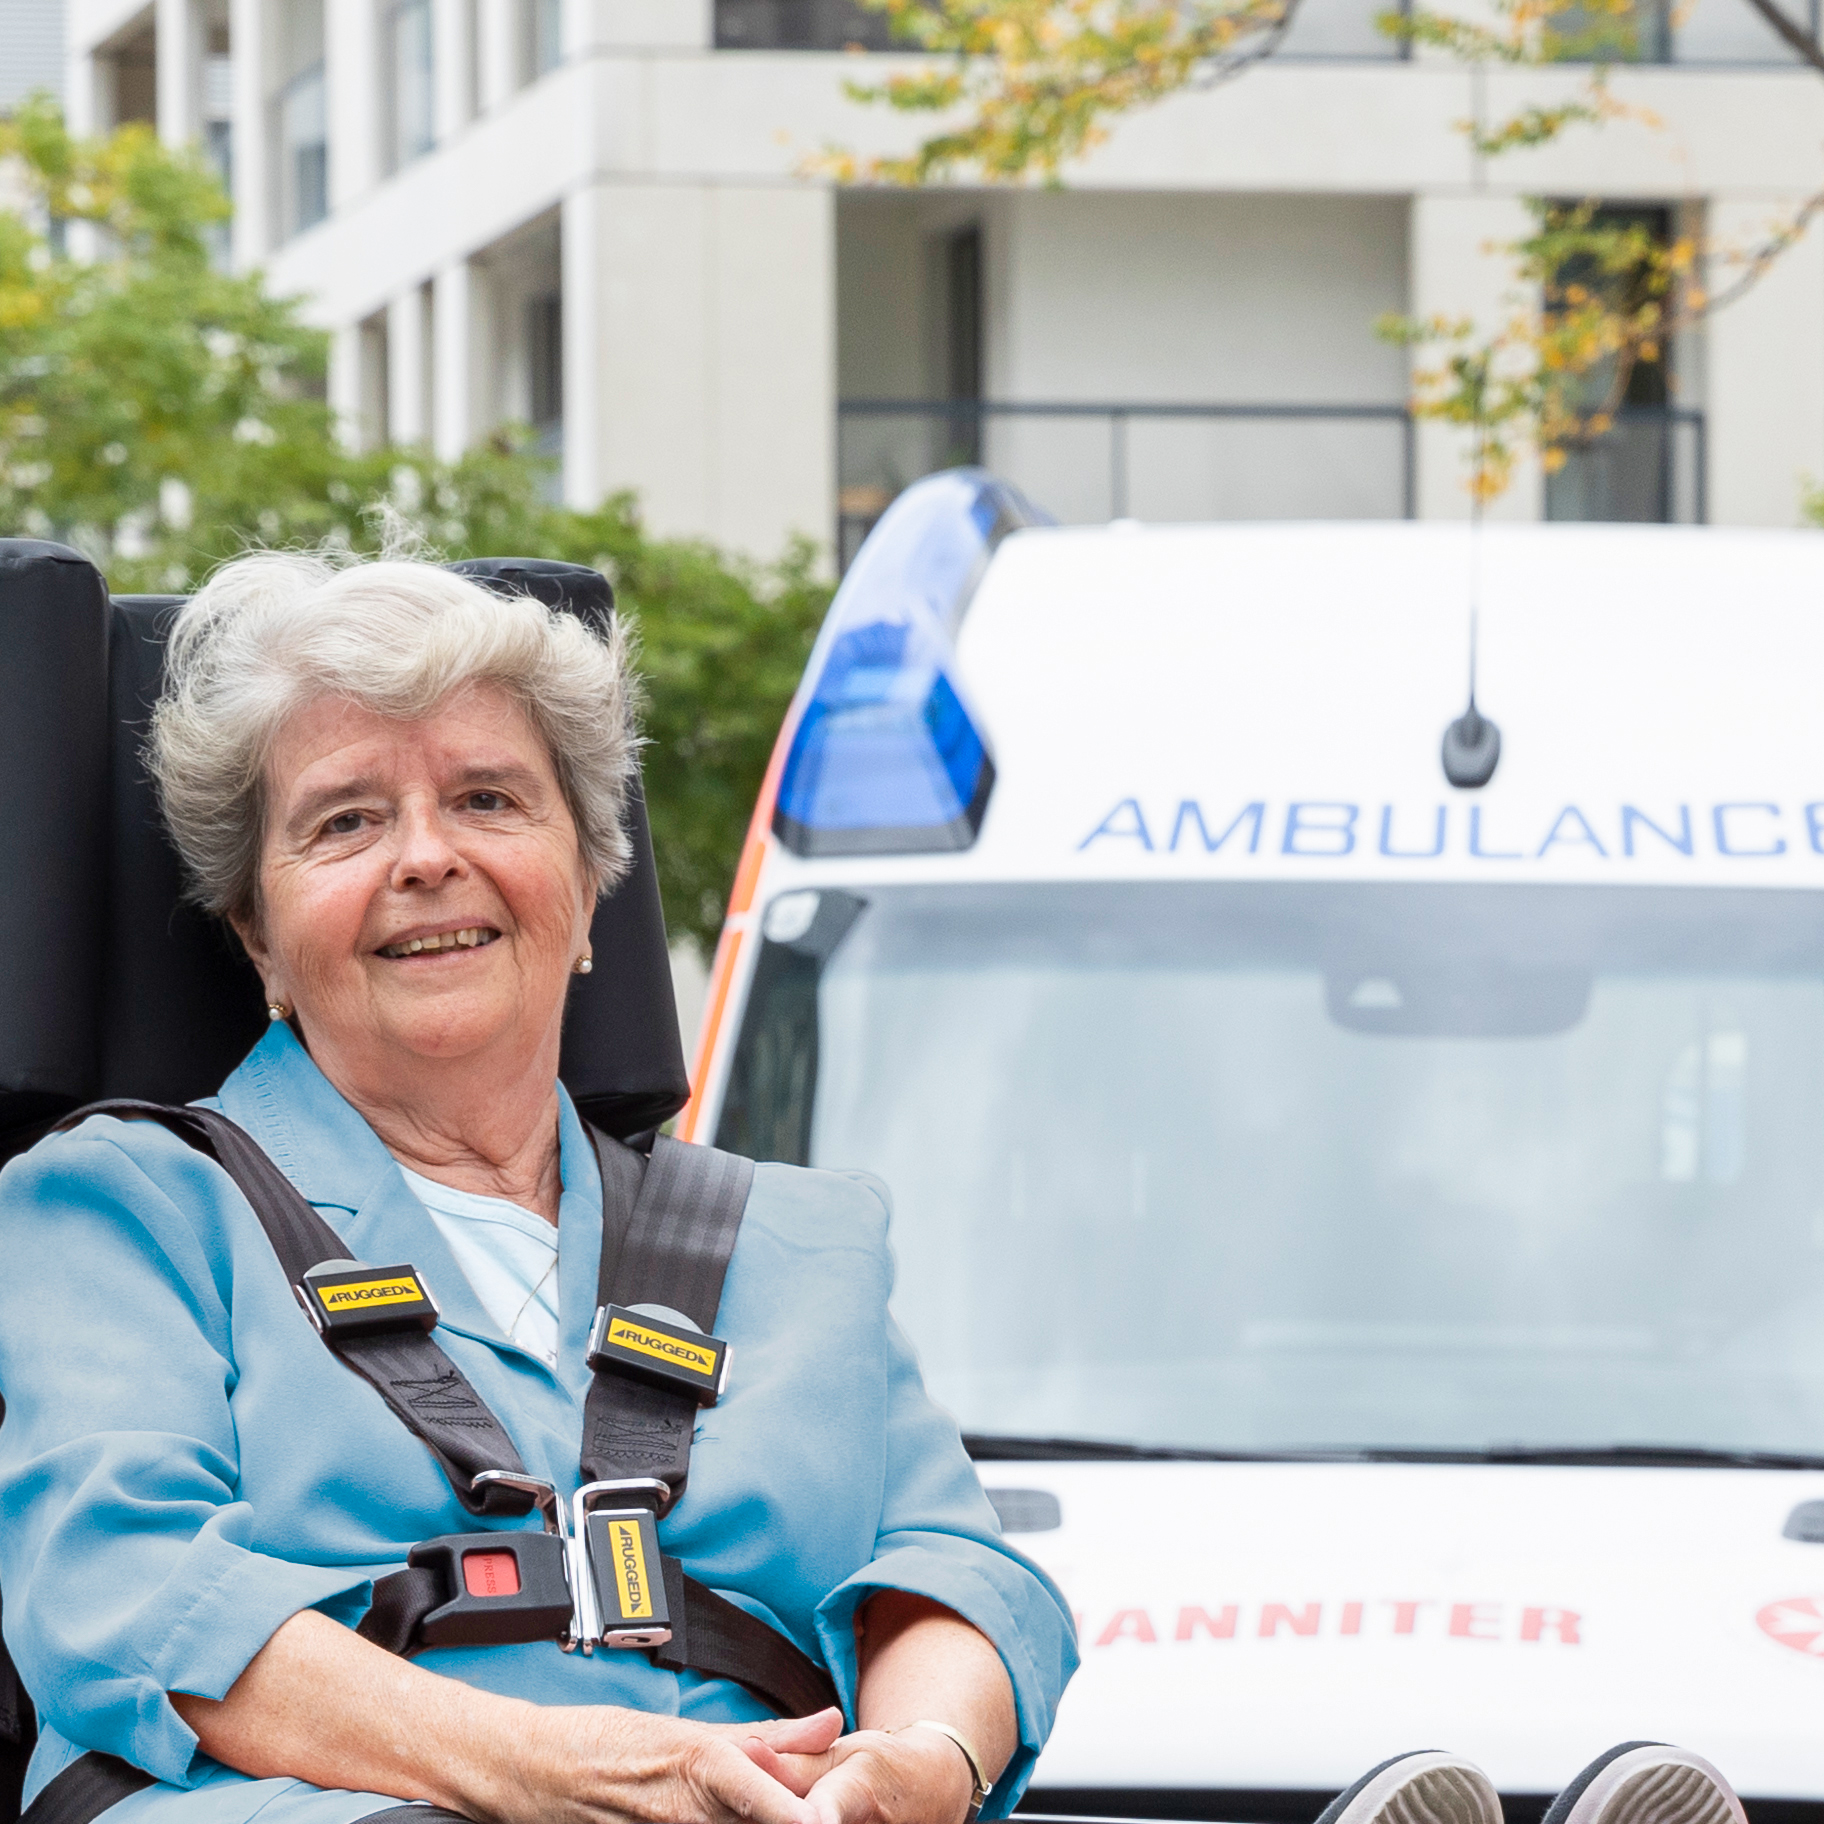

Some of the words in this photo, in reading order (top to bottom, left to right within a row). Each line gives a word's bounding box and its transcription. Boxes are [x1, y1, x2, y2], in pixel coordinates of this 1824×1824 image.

[337, 1285, 404, 1303] RUGGED
[626, 1331, 697, 1361] RUGGED
[483, 1558, 497, 1594] PRESS
[620, 1535, 642, 1604] RUGGED
[1075, 1600, 1581, 1646] ANNITER
